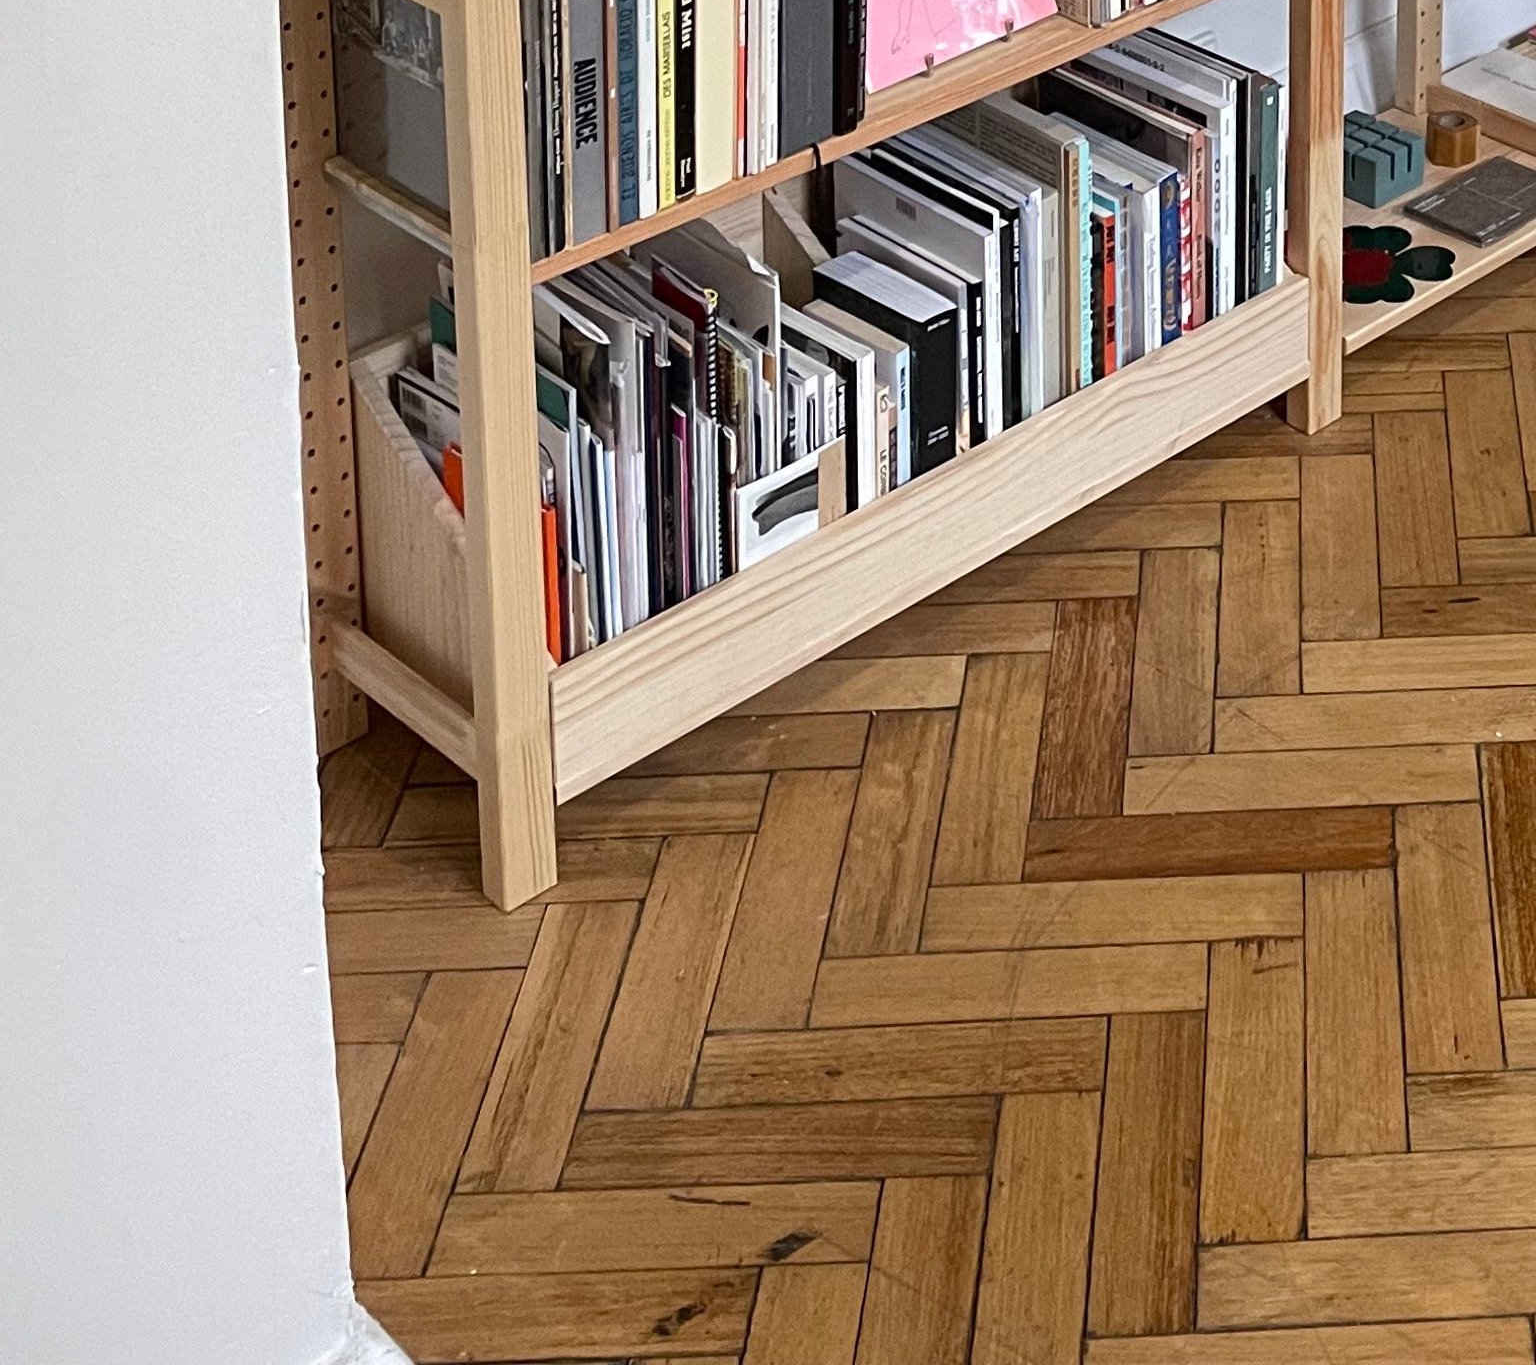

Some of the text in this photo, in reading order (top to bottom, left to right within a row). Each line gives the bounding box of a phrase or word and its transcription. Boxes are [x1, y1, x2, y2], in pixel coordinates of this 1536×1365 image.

[617, 9, 634, 60] HORACIO
[680, 8, 692, 50] Mist
[575, 58, 598, 150] AUDIENCE
[618, 91, 635, 124] AIRES
[618, 129, 636, 178] BUENOS
[878, 449, 888, 463] LE
